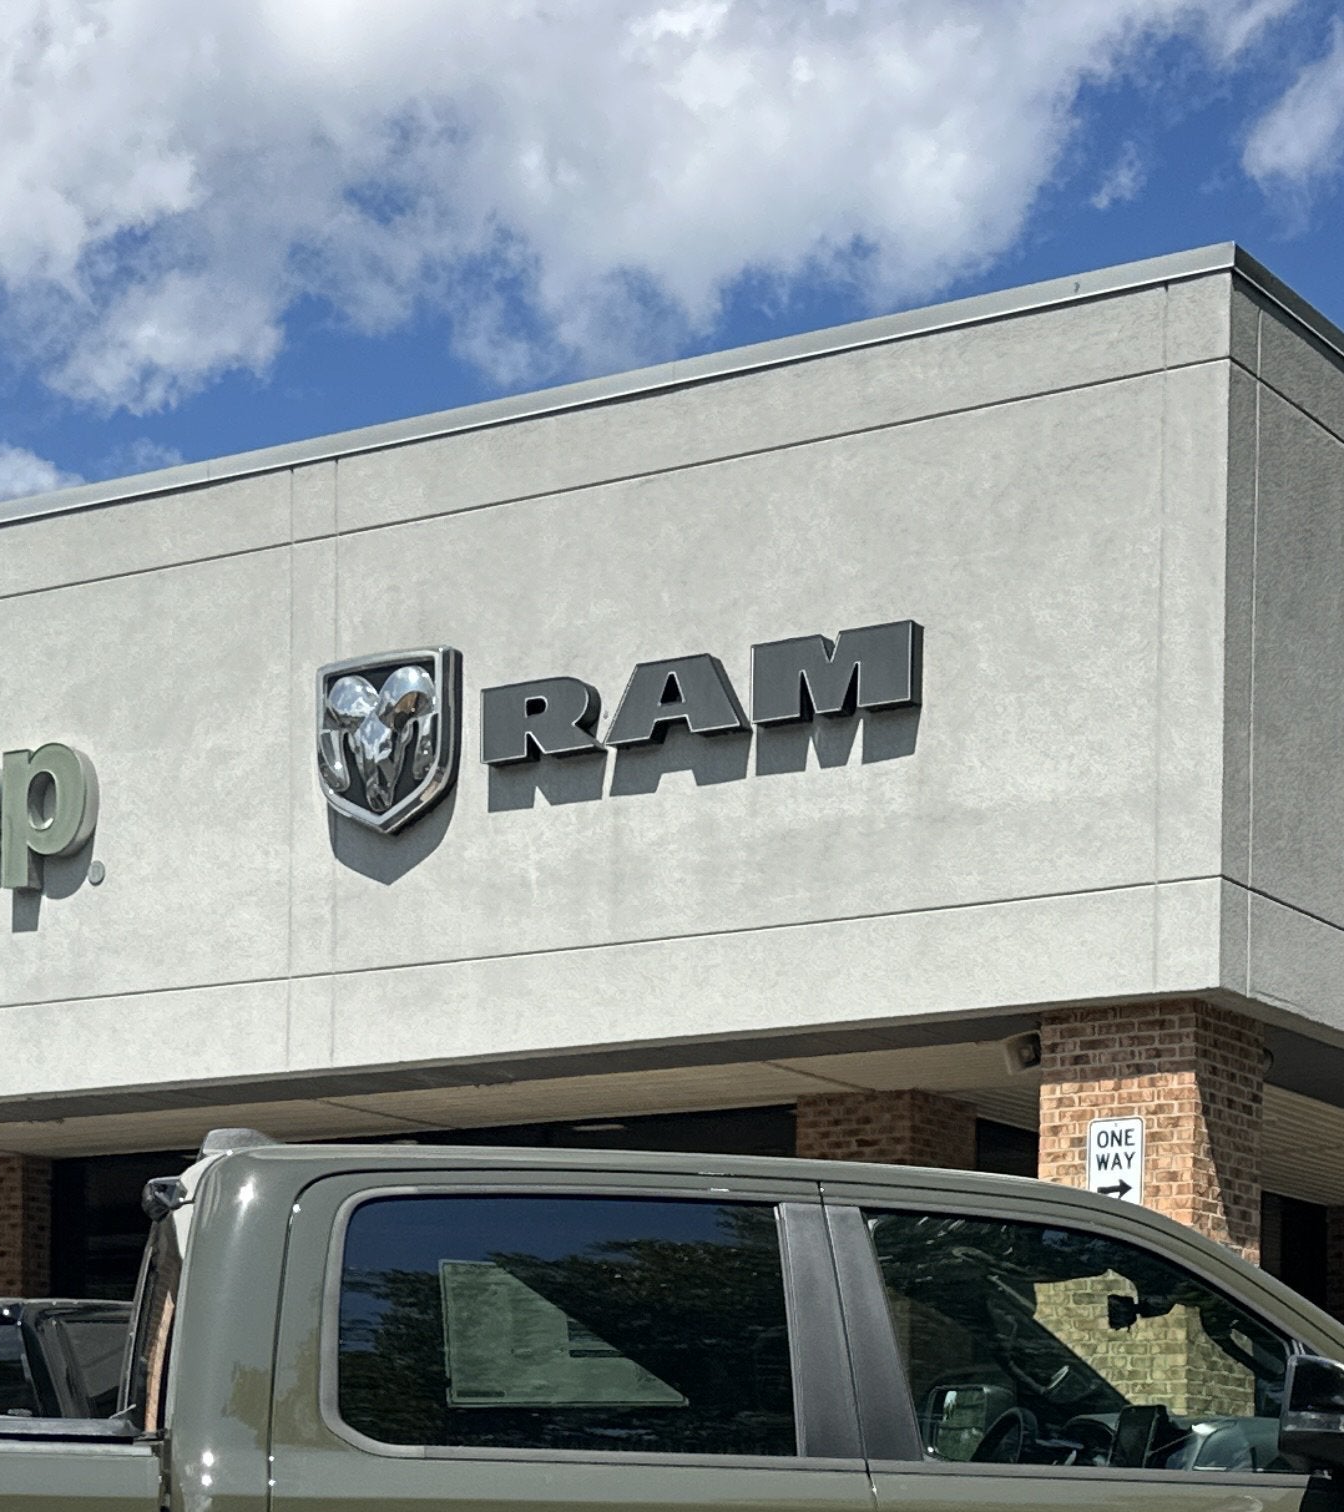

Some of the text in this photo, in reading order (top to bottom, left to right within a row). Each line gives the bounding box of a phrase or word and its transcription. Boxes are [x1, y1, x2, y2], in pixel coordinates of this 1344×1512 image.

[479, 618, 924, 766] RAM
[1096, 1128, 1136, 1149] ONE
[1095, 1151, 1137, 1171] WAY
